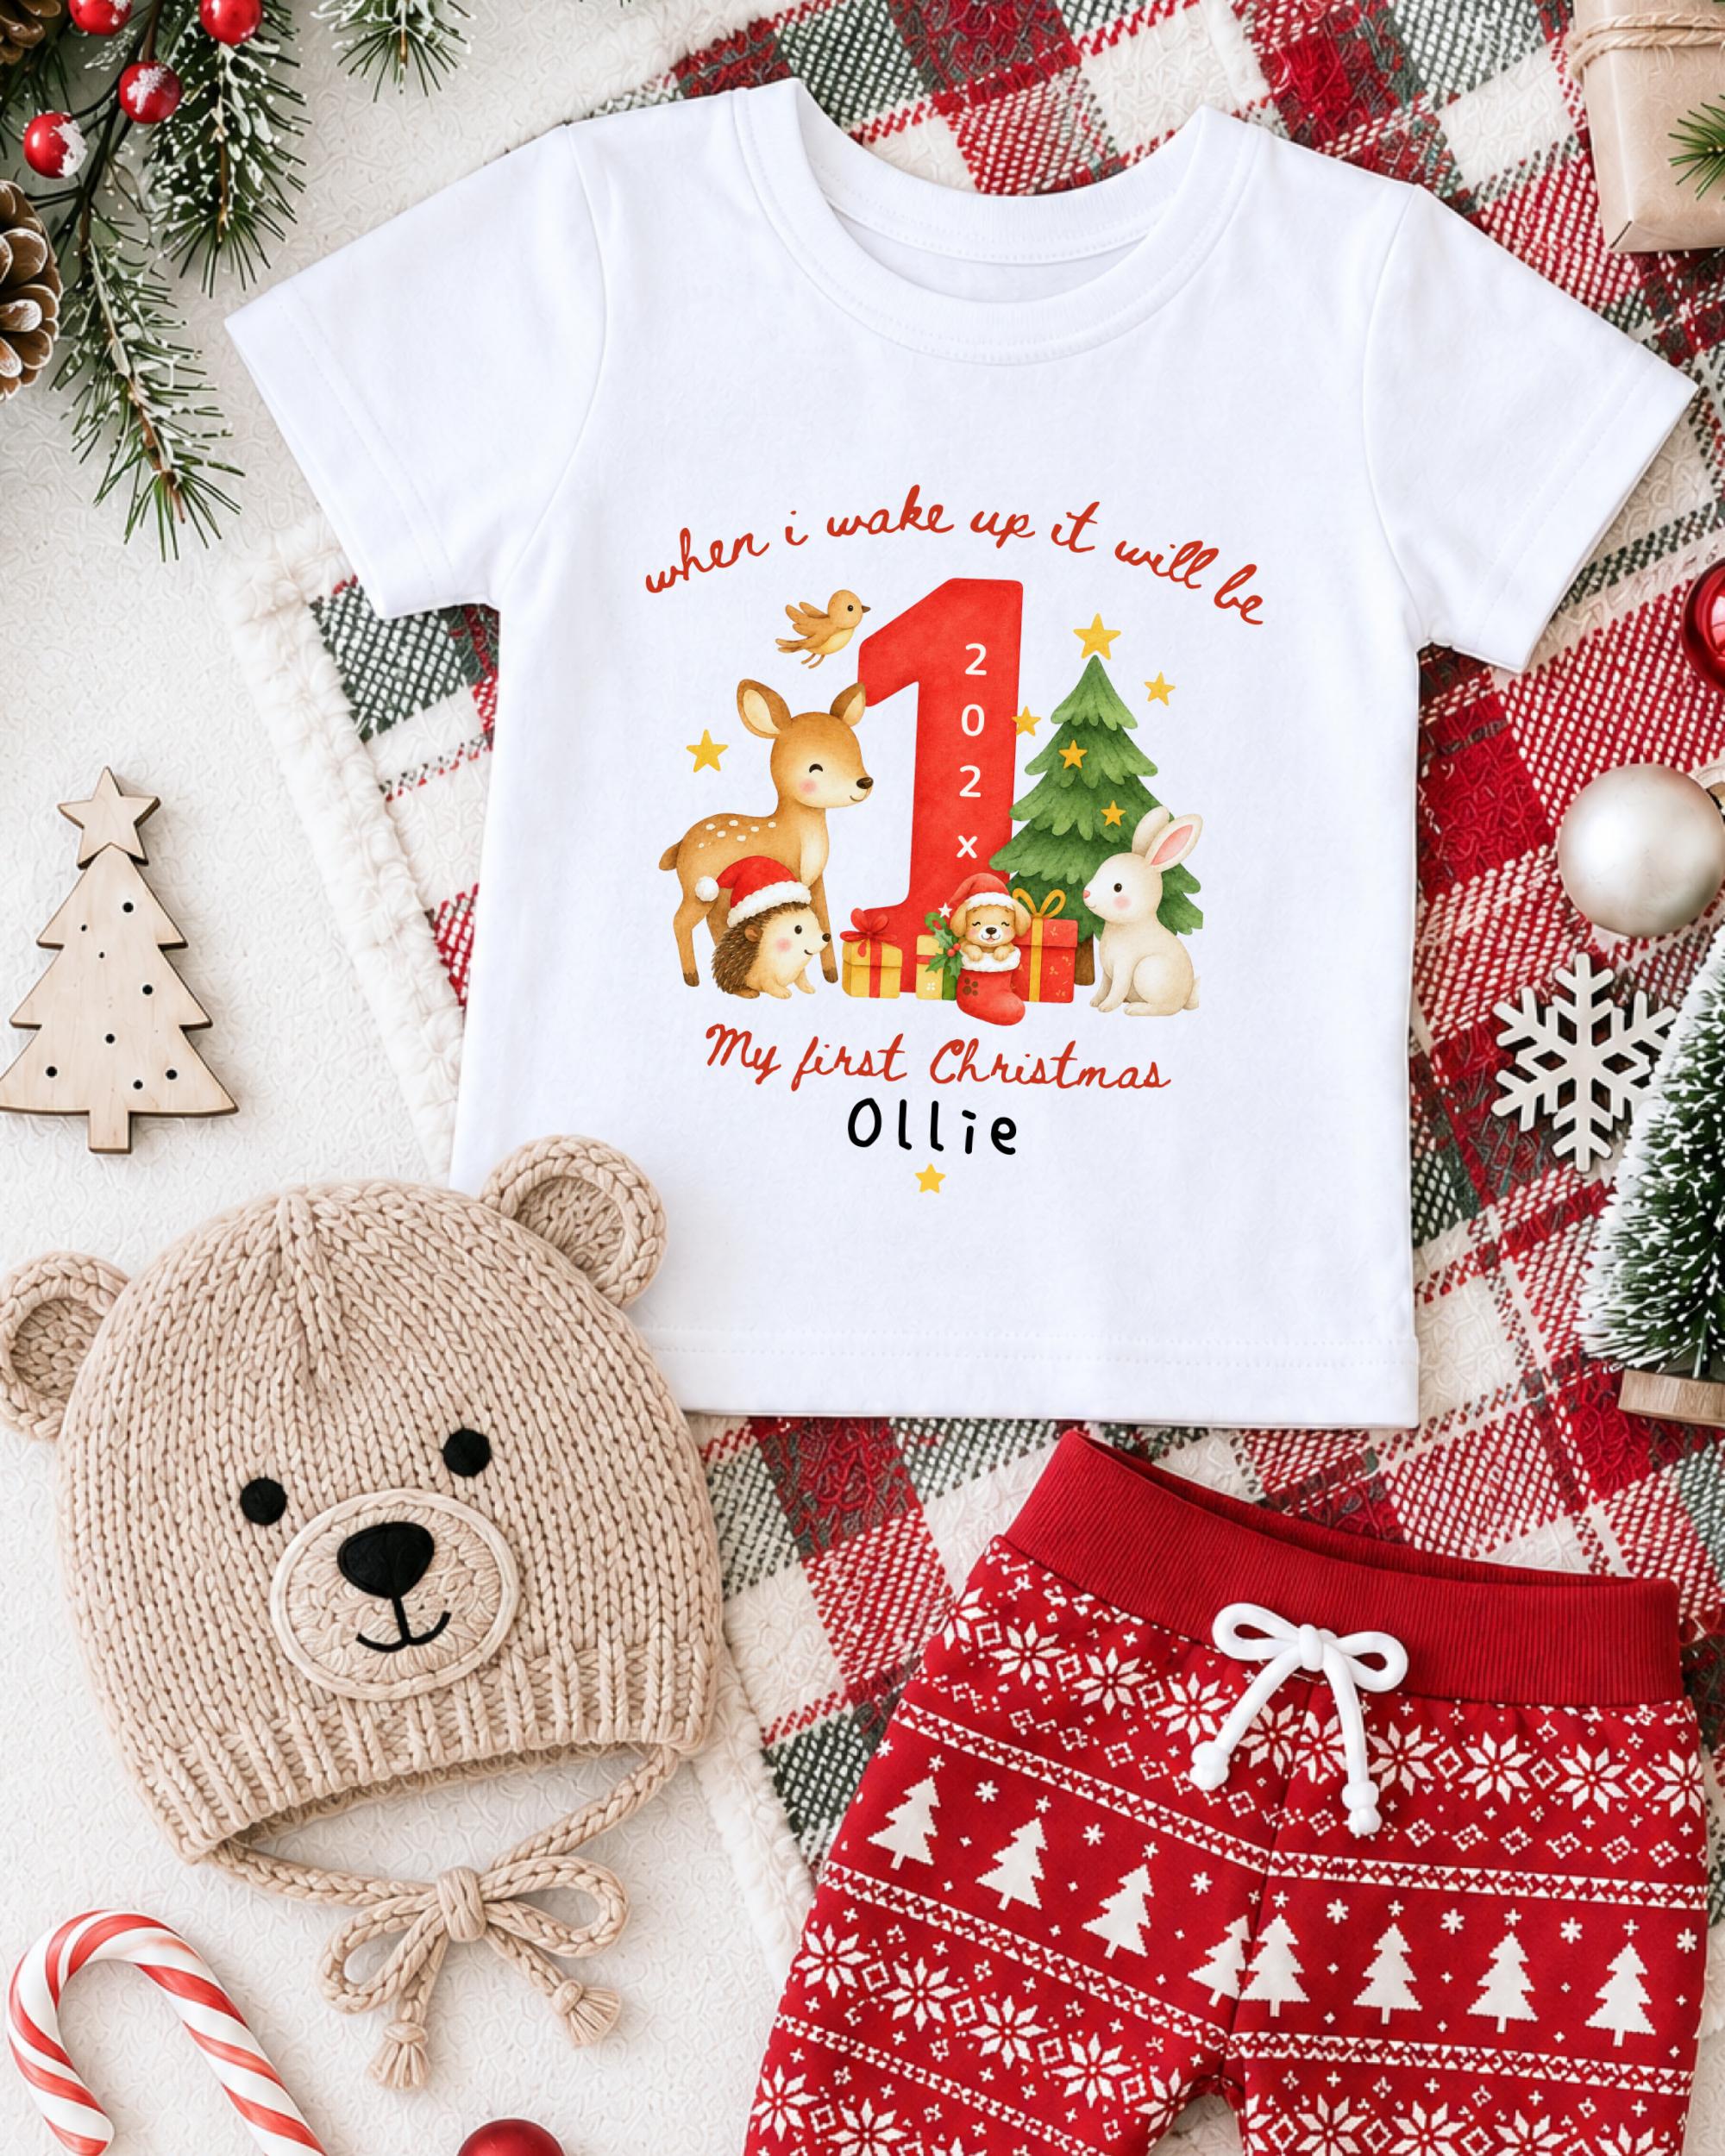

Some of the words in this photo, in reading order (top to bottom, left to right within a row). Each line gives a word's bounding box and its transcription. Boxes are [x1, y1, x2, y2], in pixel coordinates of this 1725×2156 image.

[644, 527, 769, 593] when
[784, 511, 809, 547] i
[825, 484, 955, 538] wake
[969, 510, 1035, 549] up
[1050, 500, 1101, 553] it
[1114, 539, 1220, 590] will
[1213, 563, 1264, 626] be
[706, 1023, 781, 1087] My
[790, 1032, 908, 1092] first
[928, 1037, 1172, 1090] Christmas
[847, 1097, 1018, 1156] Ollie
